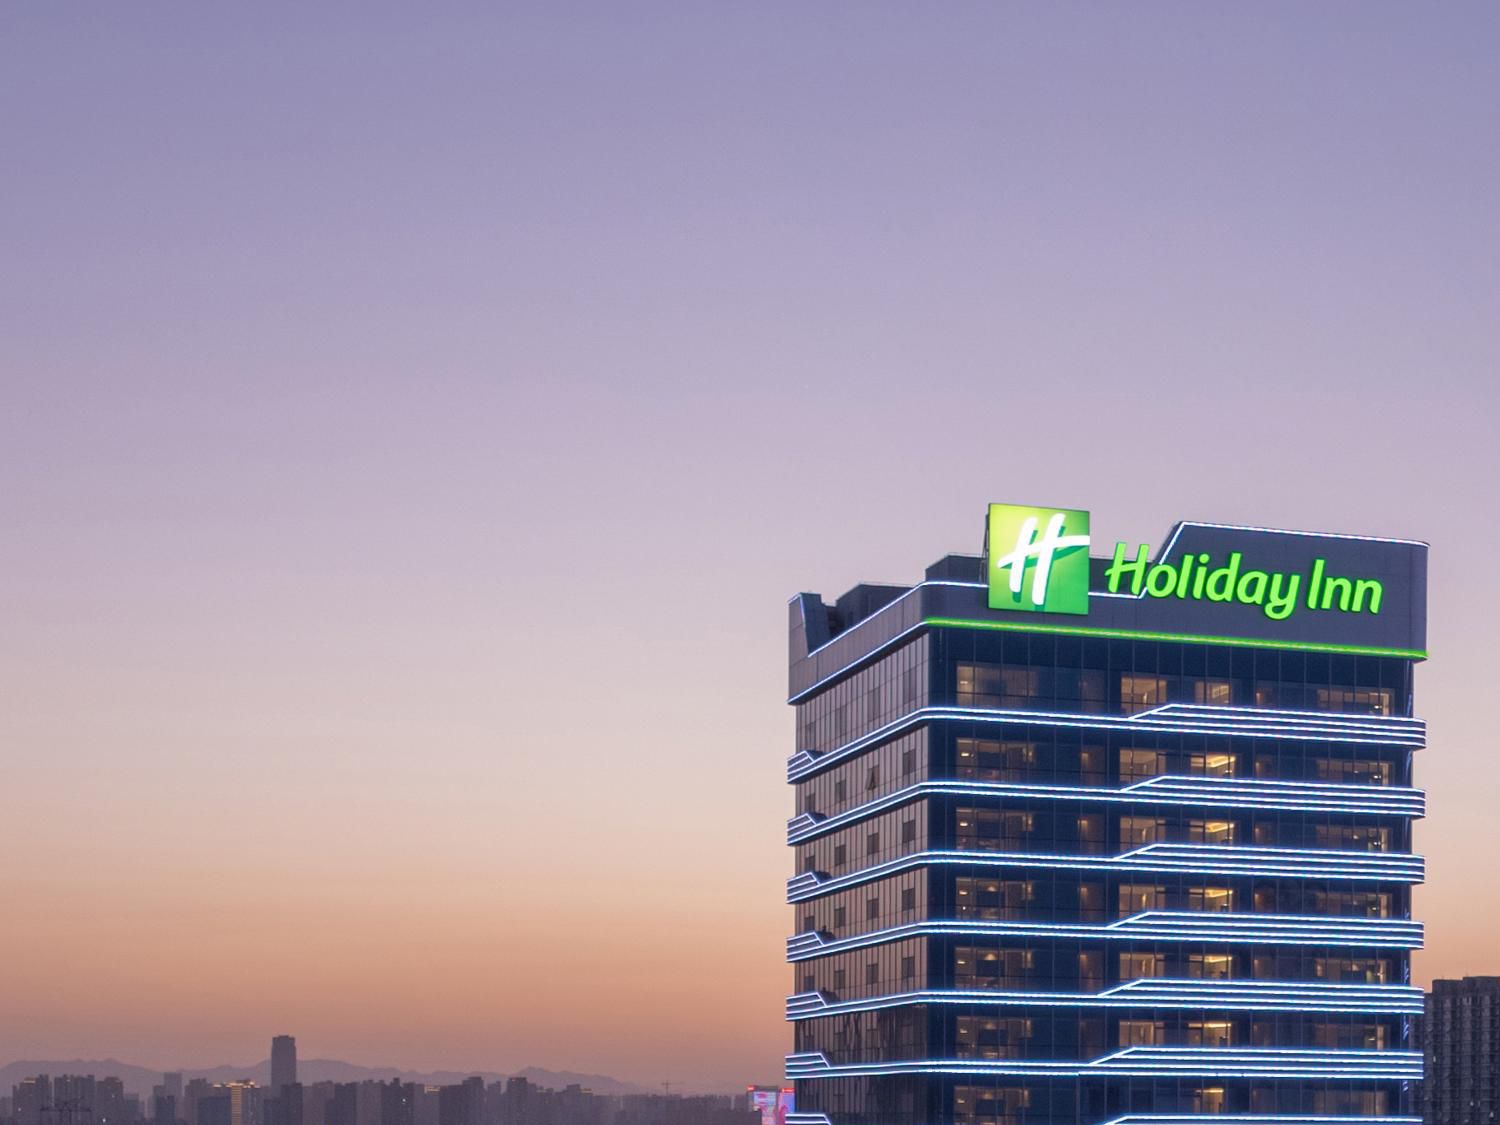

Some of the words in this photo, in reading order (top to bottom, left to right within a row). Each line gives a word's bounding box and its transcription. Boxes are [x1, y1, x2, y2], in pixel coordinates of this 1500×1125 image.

[997, 513, 1089, 605] H
[1104, 542, 1299, 620] Holiday
[1307, 559, 1383, 614] Inn
